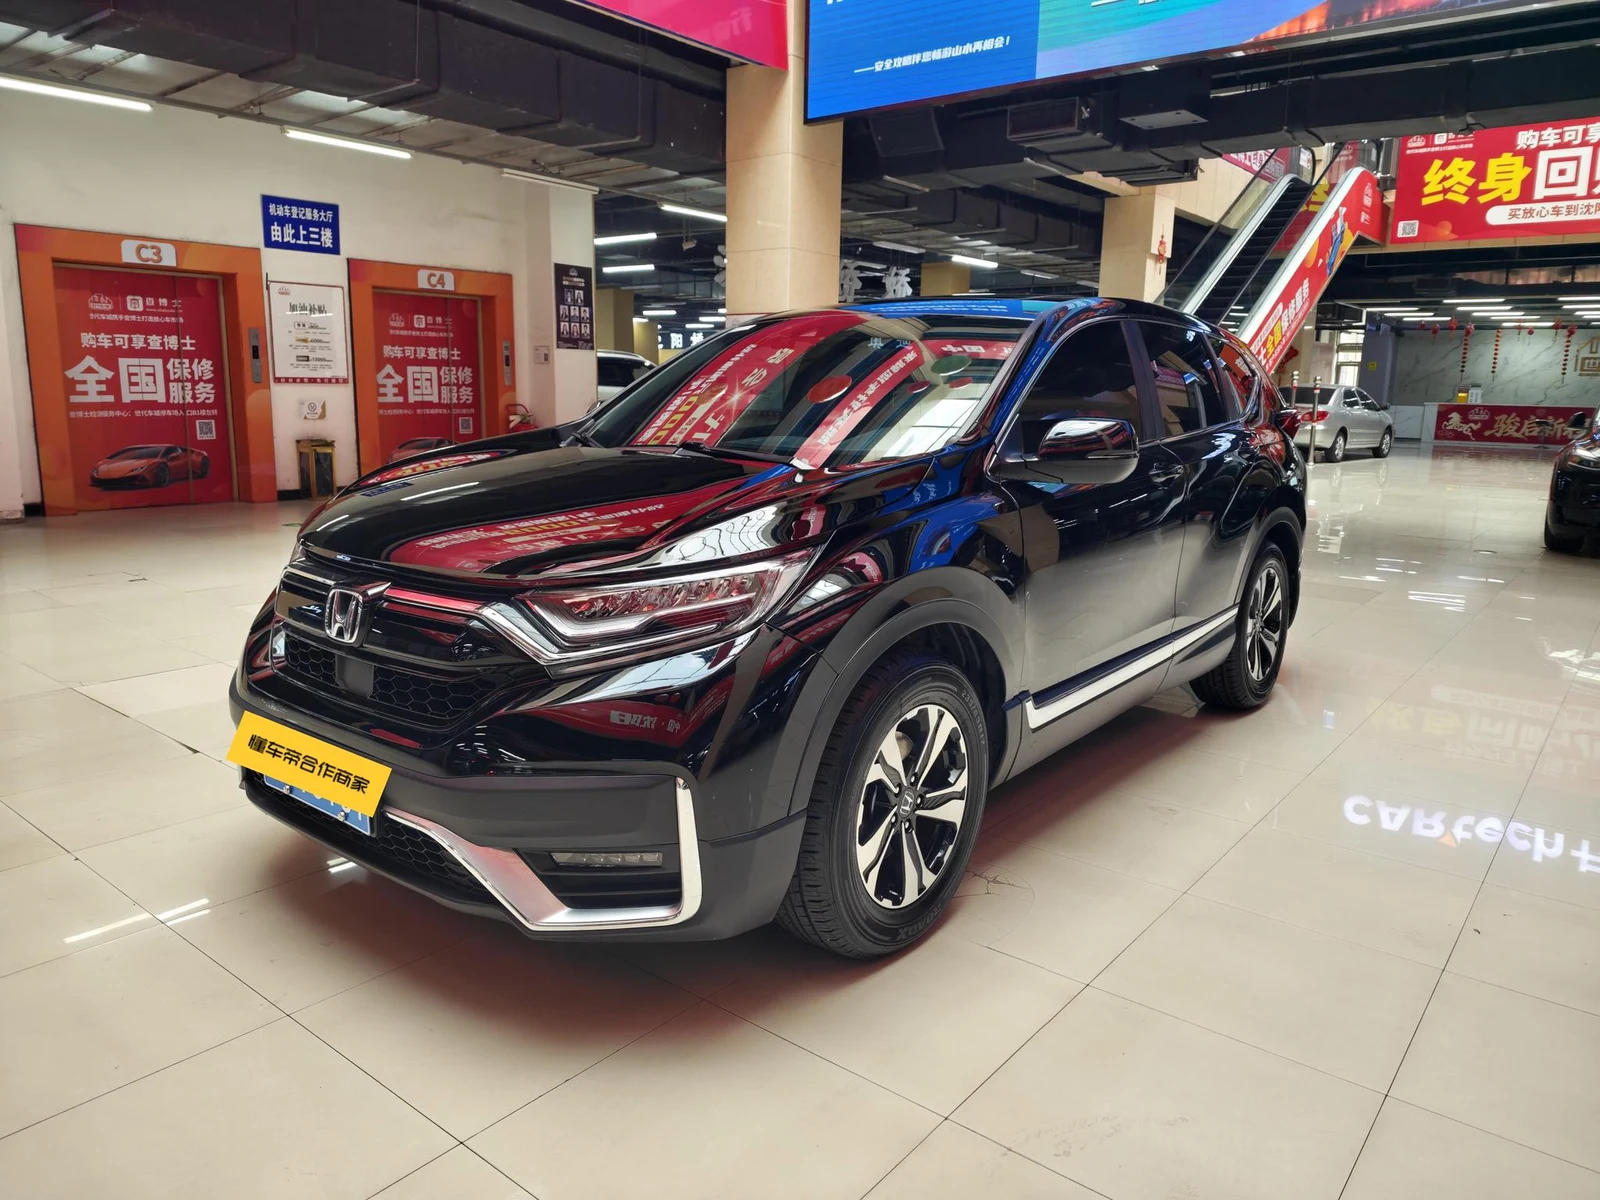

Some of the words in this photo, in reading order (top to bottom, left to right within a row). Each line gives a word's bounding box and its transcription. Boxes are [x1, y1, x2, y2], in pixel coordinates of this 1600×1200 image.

[268, 203, 333, 222] 机动车登记服务大厅
[270, 222, 333, 248] 由此上三楼
[135, 243, 163, 263] C3
[427, 272, 446, 288] C4
[80, 332, 196, 351] 购车可享查博士
[383, 345, 461, 360] 购车可享查博士
[166, 358, 215, 380] 保修
[440, 366, 473, 384] 保修
[64, 355, 167, 403] 全国
[376, 364, 439, 403] 全国
[168, 382, 216, 404] 服务
[440, 386, 473, 404] 服务
